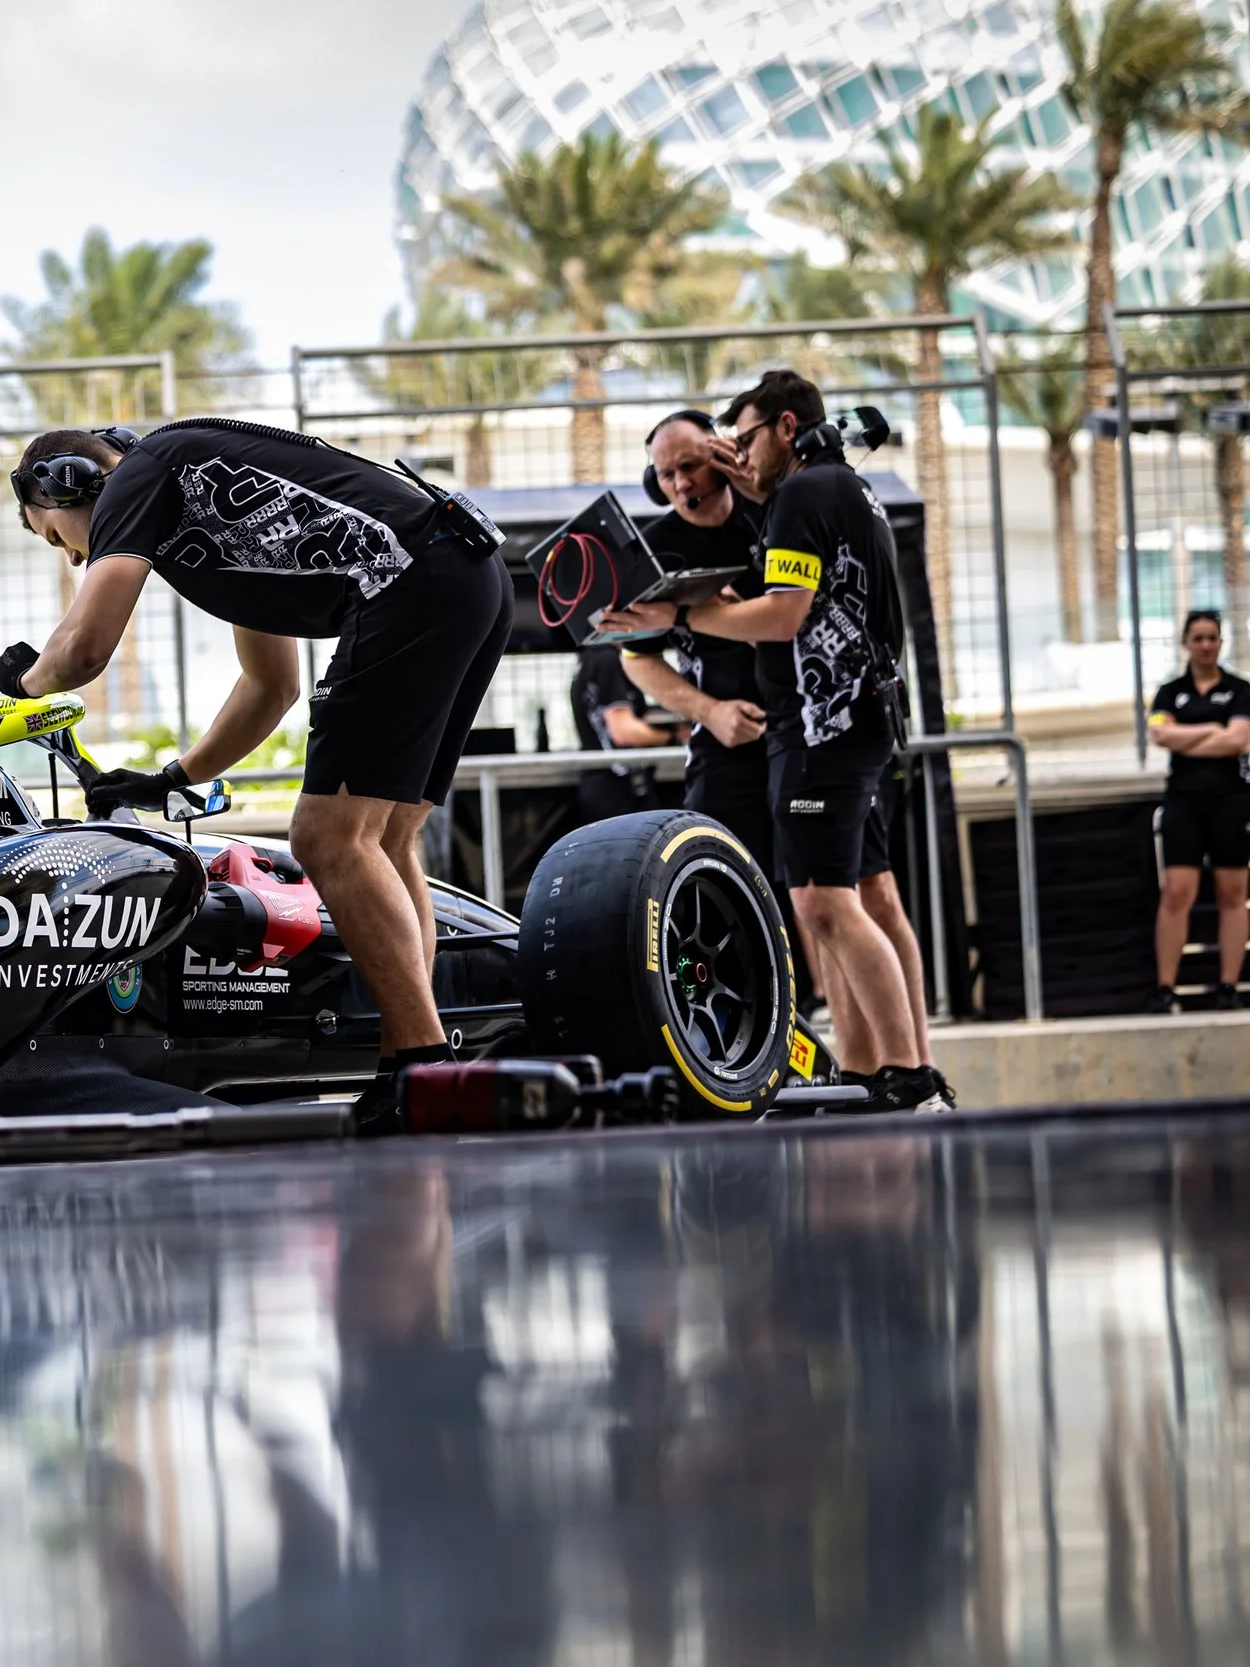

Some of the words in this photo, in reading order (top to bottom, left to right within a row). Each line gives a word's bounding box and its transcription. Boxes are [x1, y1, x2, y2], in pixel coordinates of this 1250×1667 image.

[777, 558, 820, 582] WALL
[790, 799, 825, 809] RODIN
[647, 898, 661, 973] PIRELLI
[182, 980, 227, 992] SPORTING
[229, 981, 290, 994] MANAGEMENT
[183, 996, 264, 1014] www.edge-sm.com
